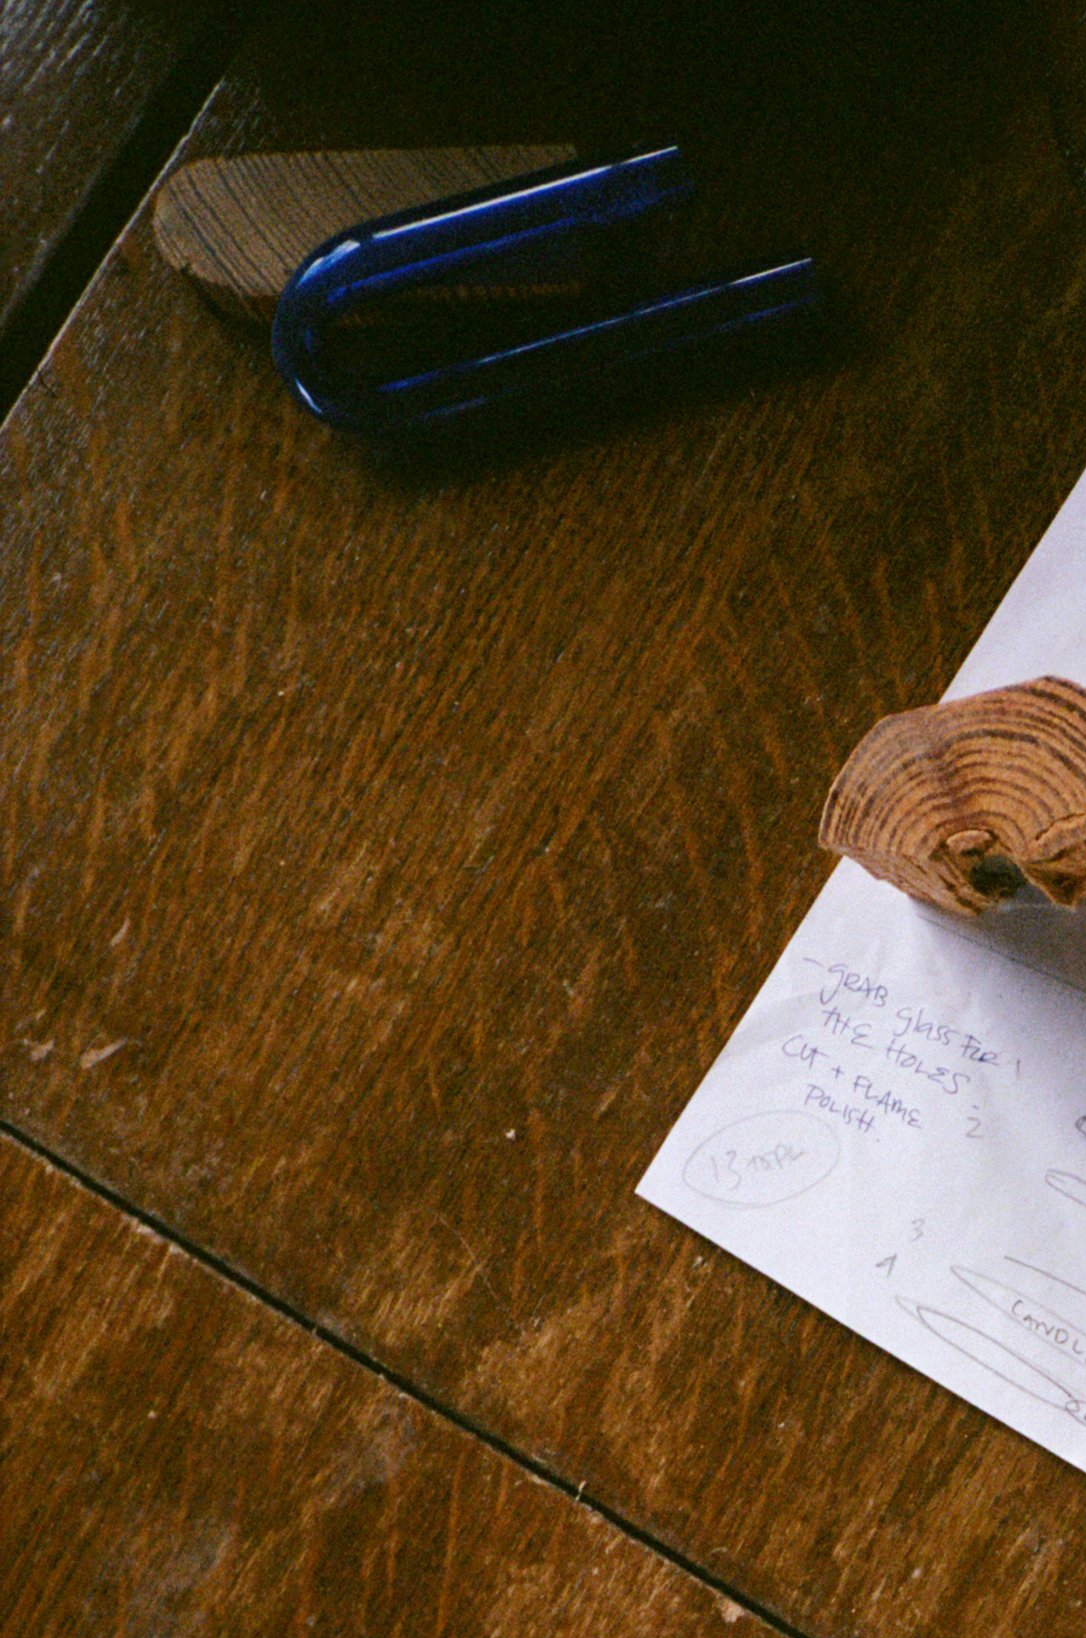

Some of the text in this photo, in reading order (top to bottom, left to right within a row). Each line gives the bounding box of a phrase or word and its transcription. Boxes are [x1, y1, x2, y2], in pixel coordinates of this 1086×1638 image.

[822, 1005, 971, 1095] THE HOLES
[852, 1075, 922, 1130] FLAME
